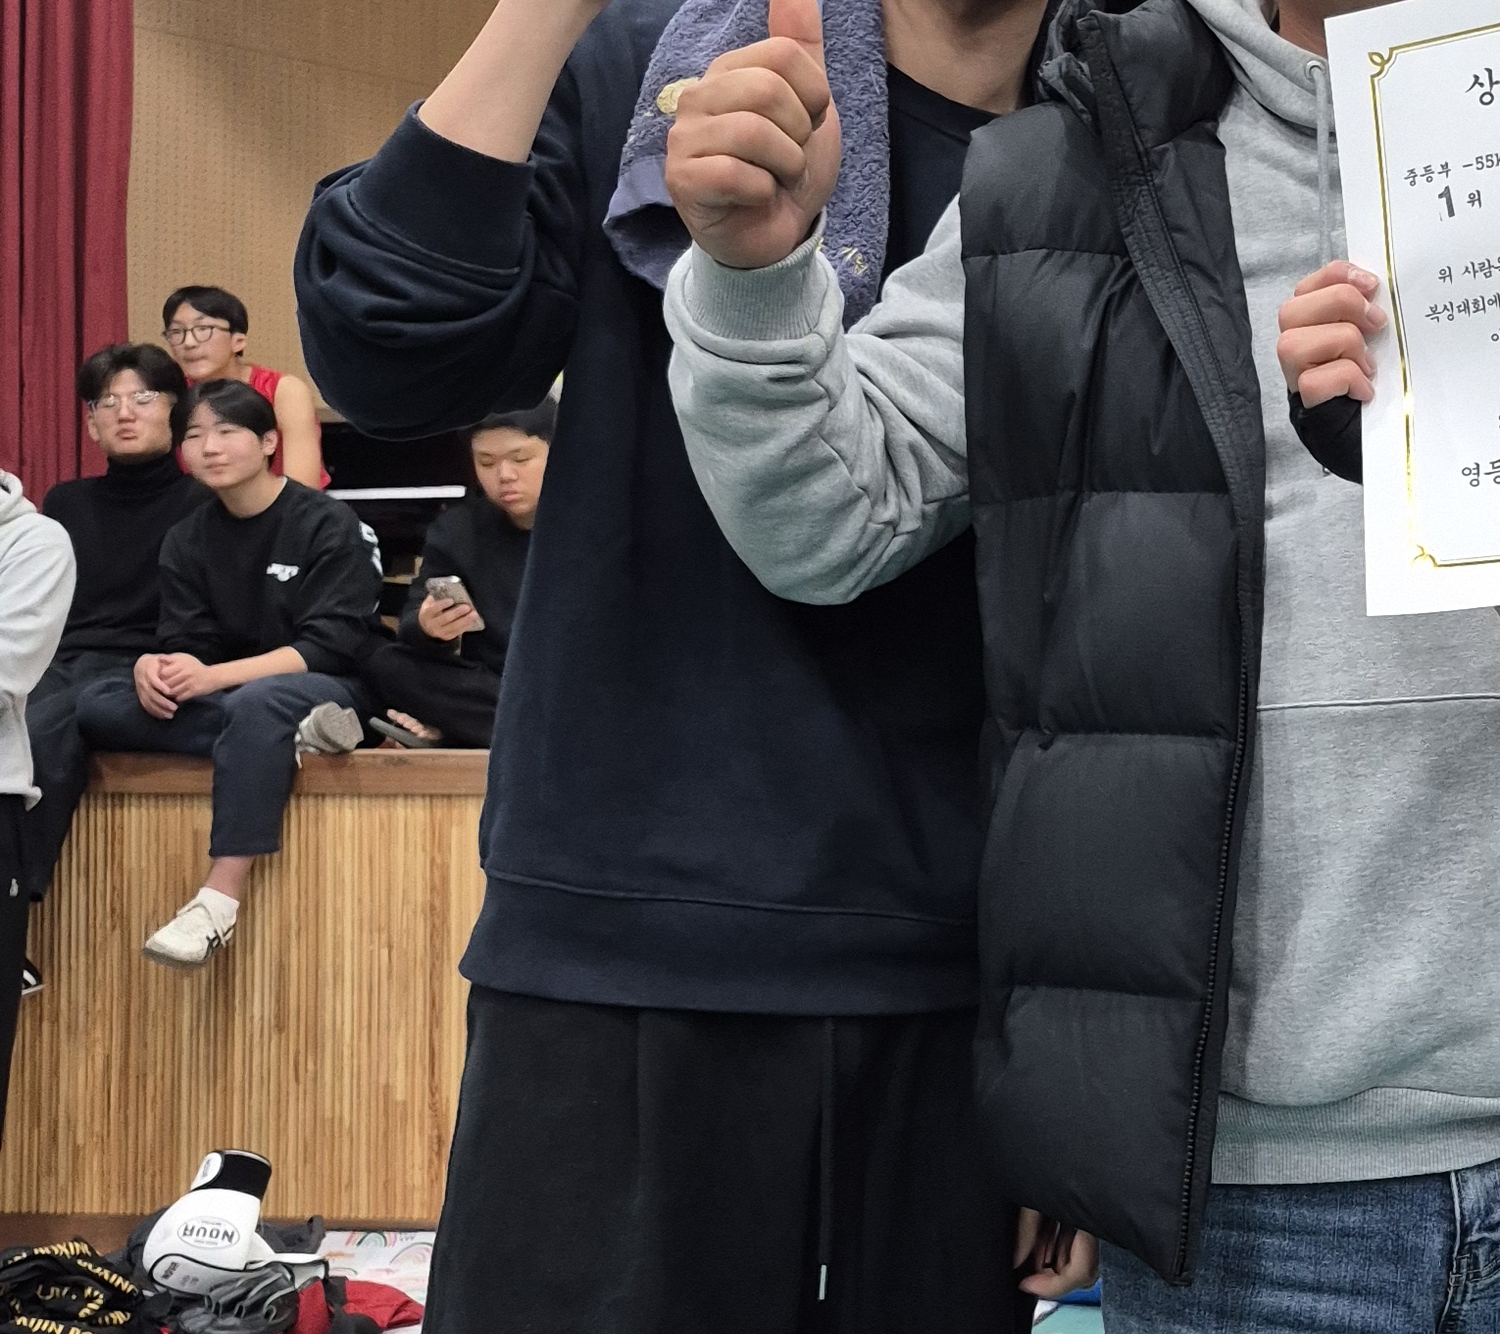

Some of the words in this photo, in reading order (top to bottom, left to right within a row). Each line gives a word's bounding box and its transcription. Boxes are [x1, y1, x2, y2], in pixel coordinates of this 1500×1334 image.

[1403, 162, 1452, 186] 중등부
[1466, 189, 1482, 209] 위
[1438, 265, 1453, 284] 위
